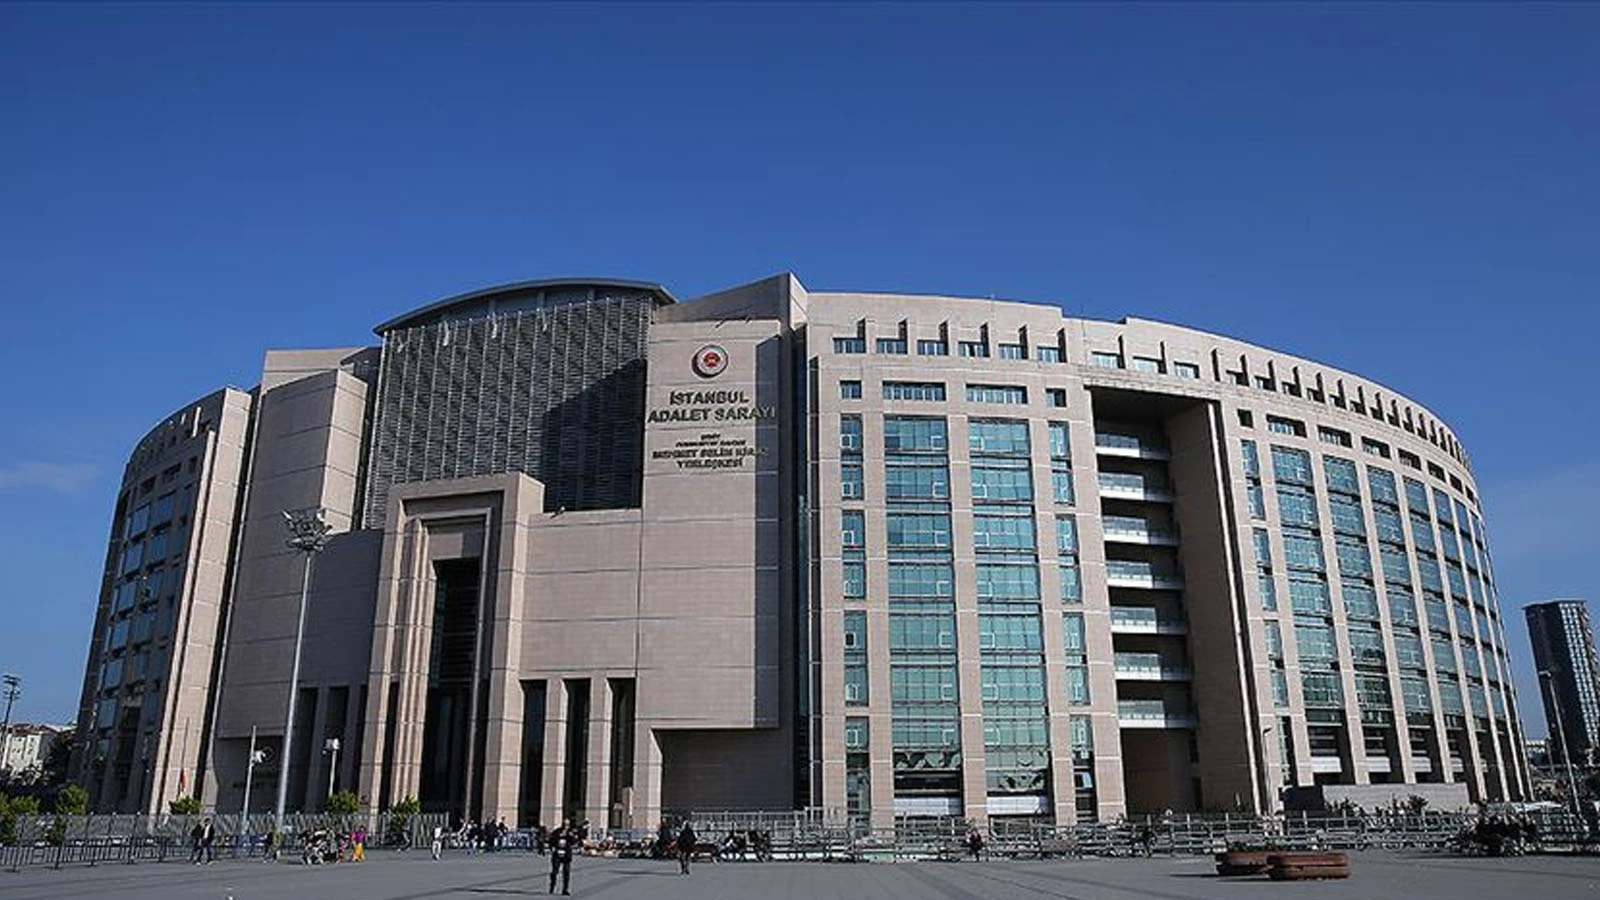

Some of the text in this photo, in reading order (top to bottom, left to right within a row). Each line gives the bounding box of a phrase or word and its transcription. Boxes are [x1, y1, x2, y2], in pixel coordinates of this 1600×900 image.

[669, 391, 750, 405] İSTANBUL
[648, 406, 776, 423] ADALET SARAYI
